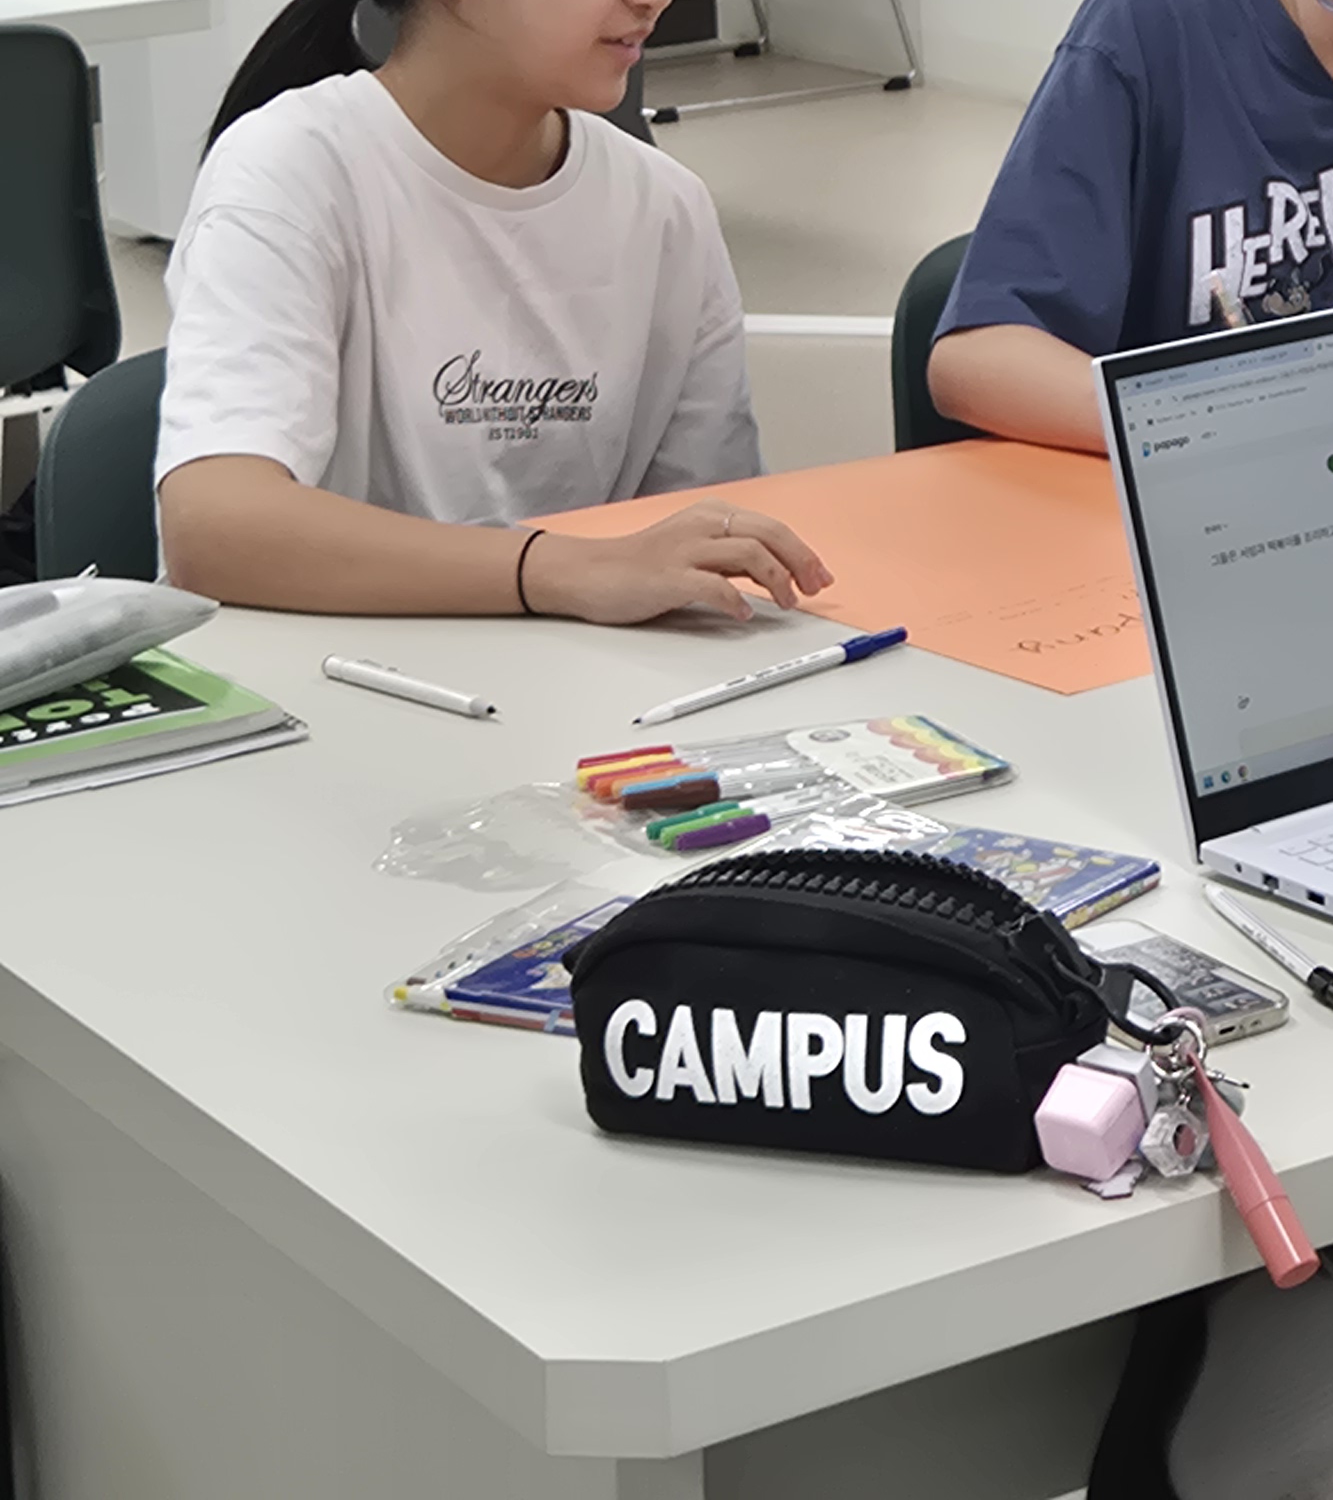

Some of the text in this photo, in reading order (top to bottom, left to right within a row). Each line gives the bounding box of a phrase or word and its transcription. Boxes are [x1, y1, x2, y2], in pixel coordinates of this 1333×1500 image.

[432, 349, 599, 425] Strangers
[1153, 435, 1191, 453] papago
[603, 998, 966, 1116] CAMPUS
